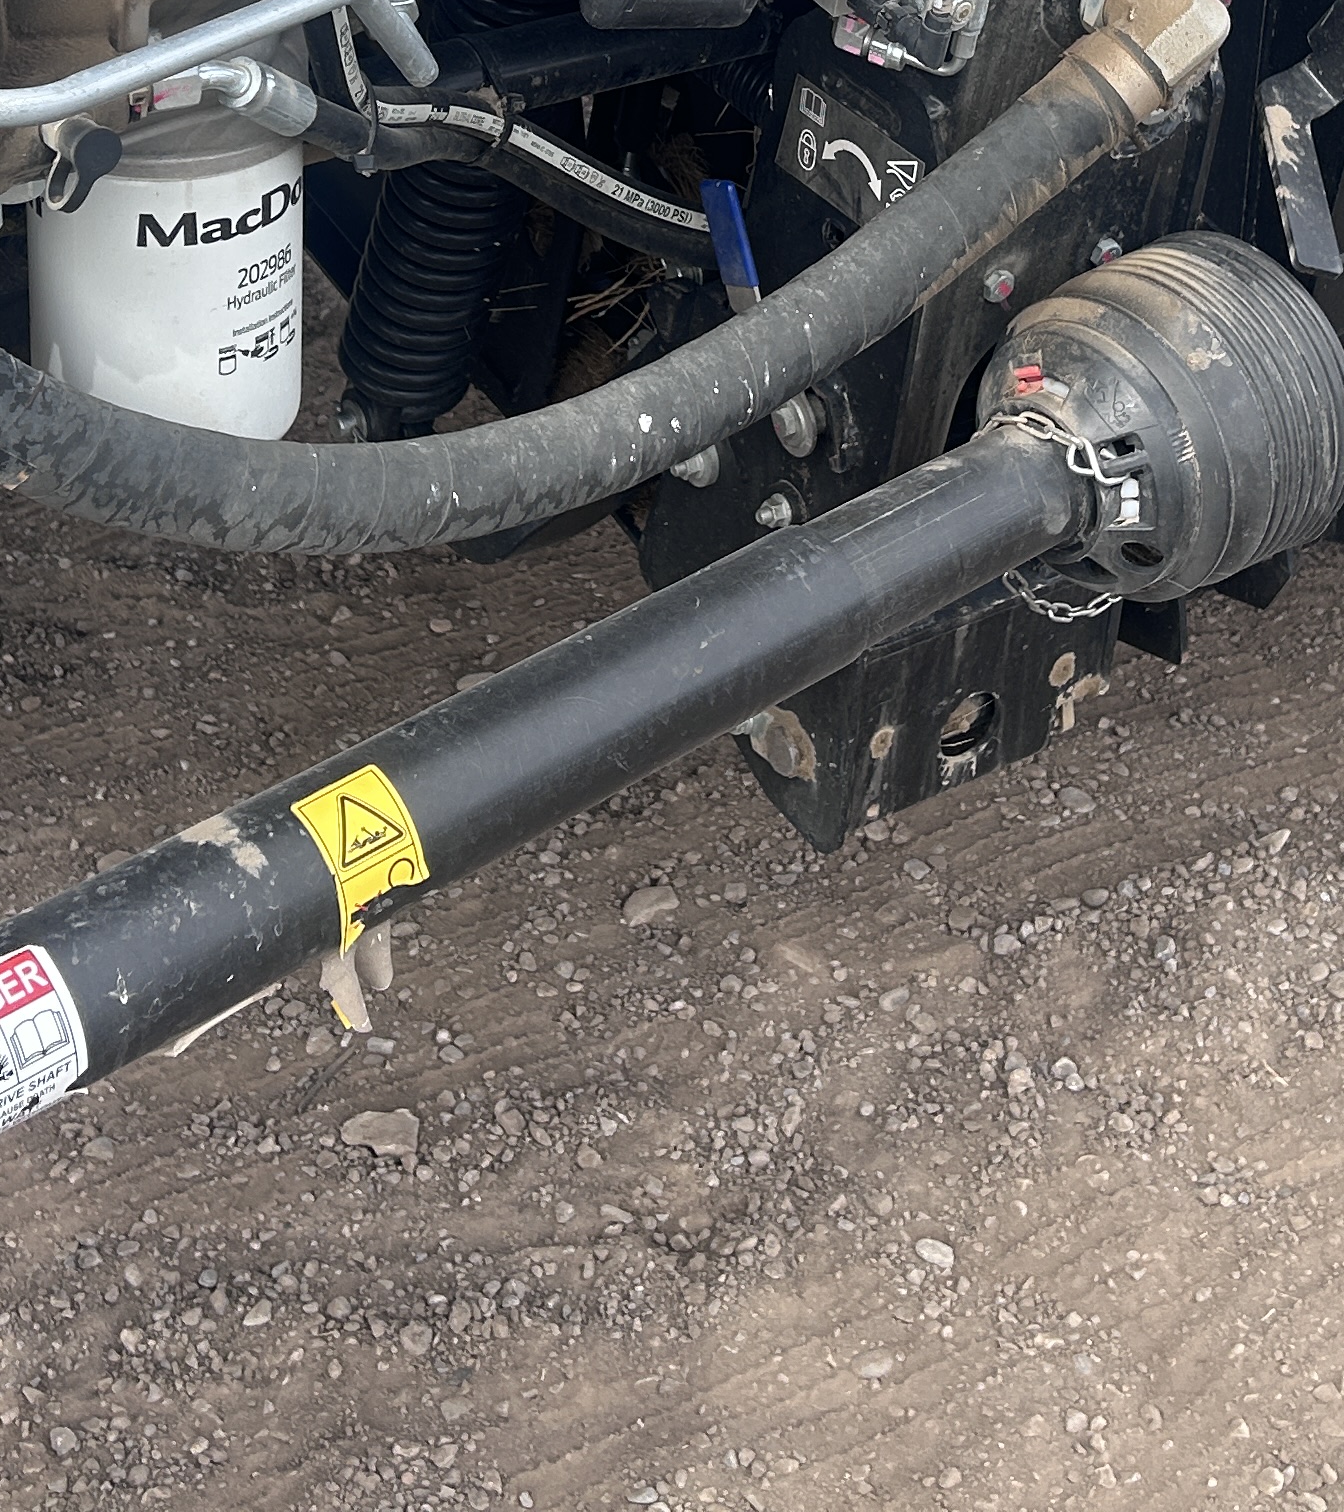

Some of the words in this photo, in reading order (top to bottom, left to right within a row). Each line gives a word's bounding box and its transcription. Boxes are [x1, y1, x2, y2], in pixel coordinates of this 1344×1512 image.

[136, 175, 303, 248] MacDo
[610, 184, 623, 198] 21
[624, 190, 644, 208] MPa
[645, 198, 670, 218] (3000
[671, 208, 693, 224] PSI)
[227, 279, 277, 310] Hydraulic
[278, 264, 297, 288] Filter
[238, 243, 291, 289] 202986
[232, 316, 268, 337] Installation
[28, 1060, 72, 1088] SHAFT
